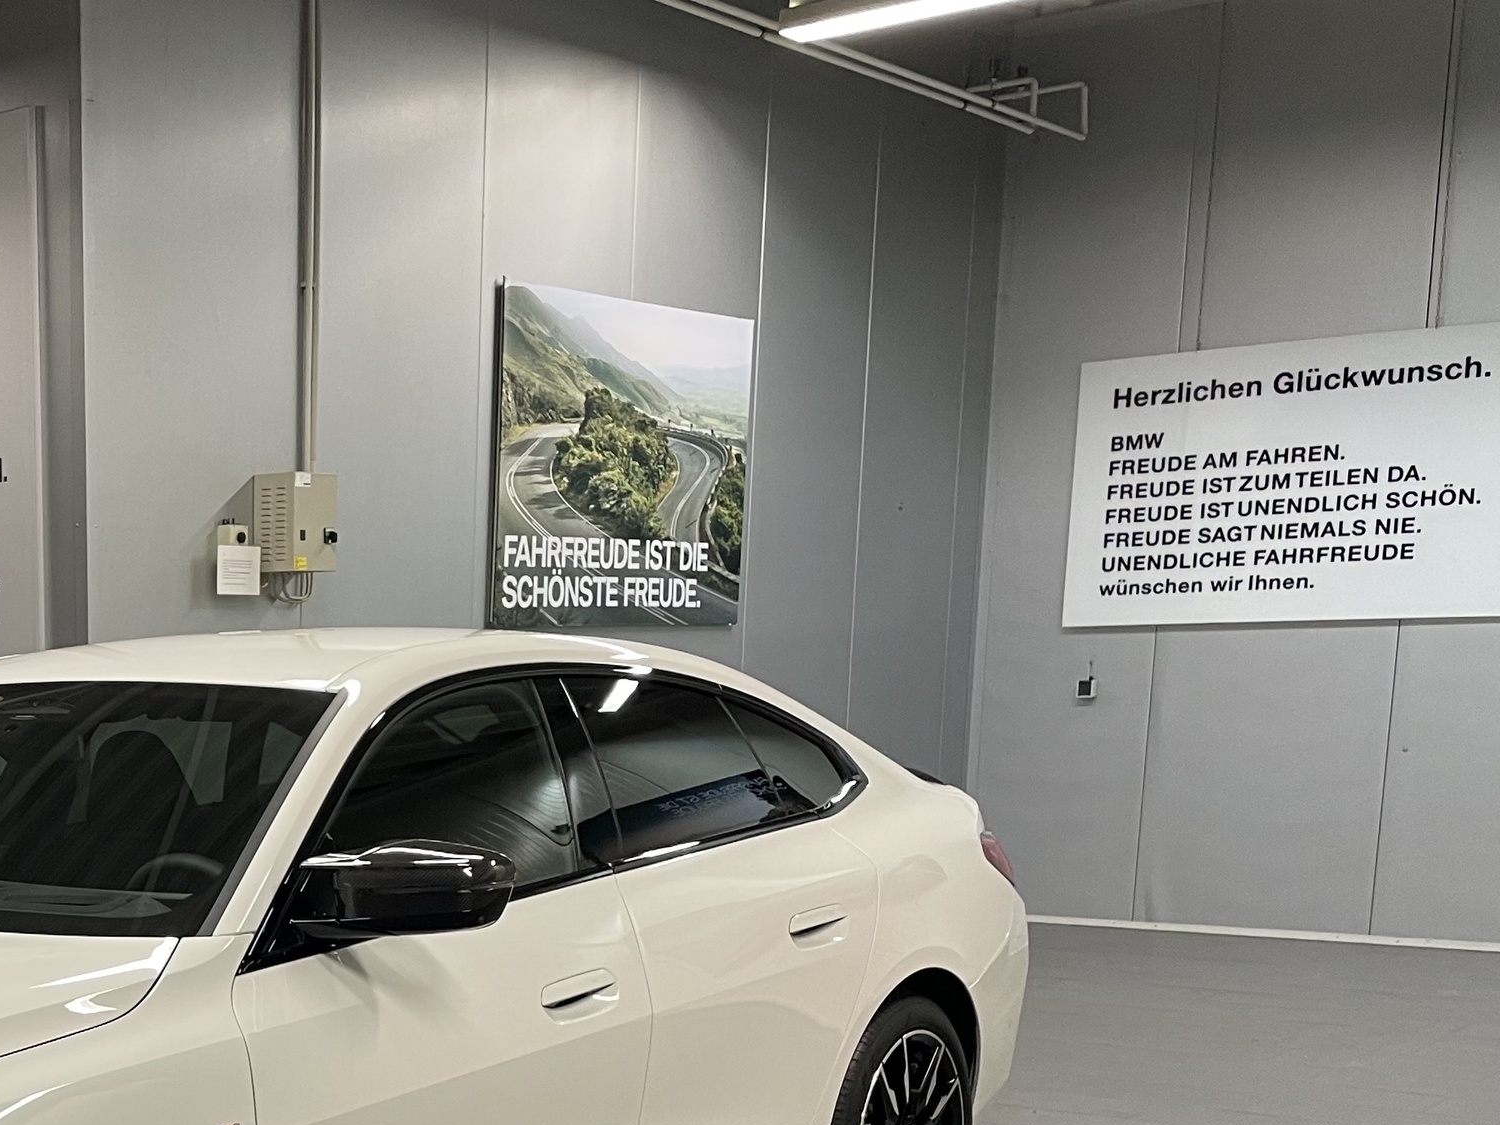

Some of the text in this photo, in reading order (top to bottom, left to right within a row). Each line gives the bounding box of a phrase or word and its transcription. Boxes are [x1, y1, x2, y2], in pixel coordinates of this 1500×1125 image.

[1113, 356, 1491, 409] Herzlichen Glückwunsch.
[1111, 432, 1164, 452] BMW
[1109, 444, 1345, 476] FREUDE AM FAHREN.
[1107, 465, 1427, 500] FREUDE IST ZUM TEILEN DA.
[1105, 483, 1481, 524] FREUDE IST UNENDLICH SCHÖN.
[1103, 517, 1422, 549] FREUDE SAGT NIEMALS NIE.
[503, 535, 709, 572] FAHRFREUDE IST DIE
[1102, 543, 1415, 572] UNENDLICHE FAHRFREUDE
[501, 568, 701, 608] SCHÖNSTE FREUDE.
[1100, 575, 1315, 596] wünschen wir Ihnen.
